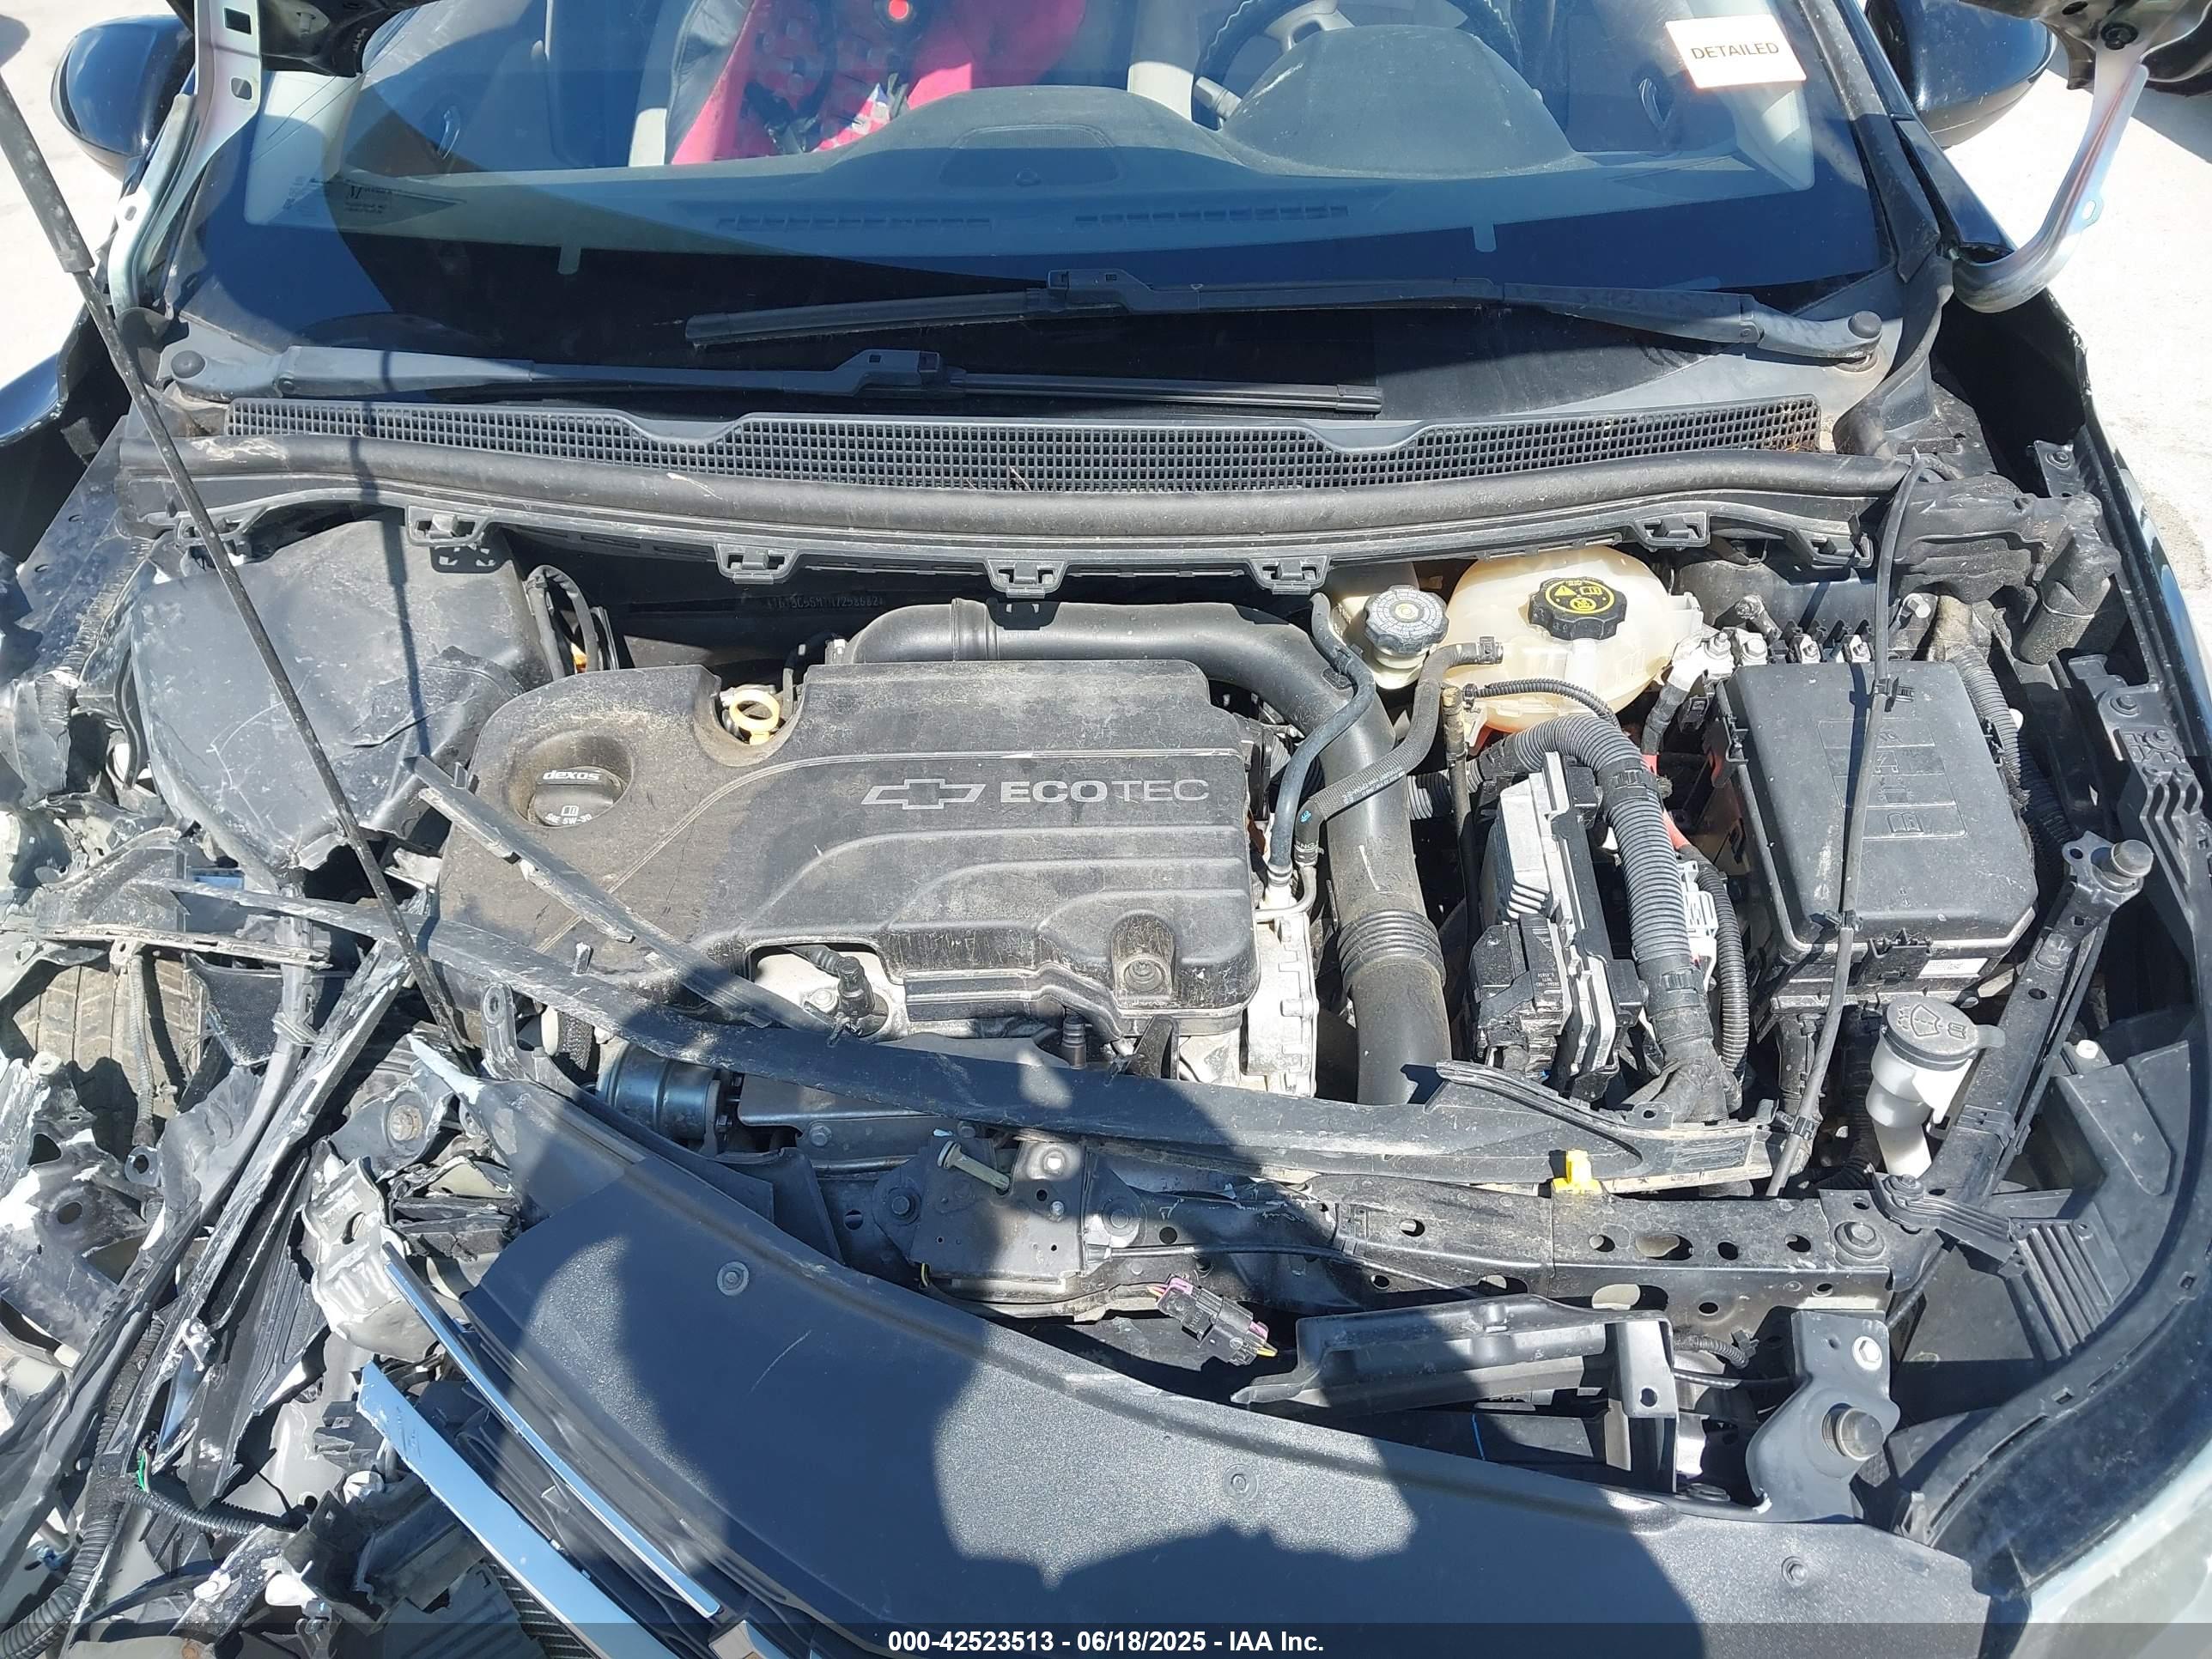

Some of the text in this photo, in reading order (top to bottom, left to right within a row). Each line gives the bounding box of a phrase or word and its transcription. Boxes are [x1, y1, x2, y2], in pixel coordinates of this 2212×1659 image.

[1691, 42, 1779, 59] DETAILED
[543, 769, 600, 781] dexos
[1000, 779, 1210, 804] ECOTEC
[544, 812, 592, 825] SAE 5W-30
